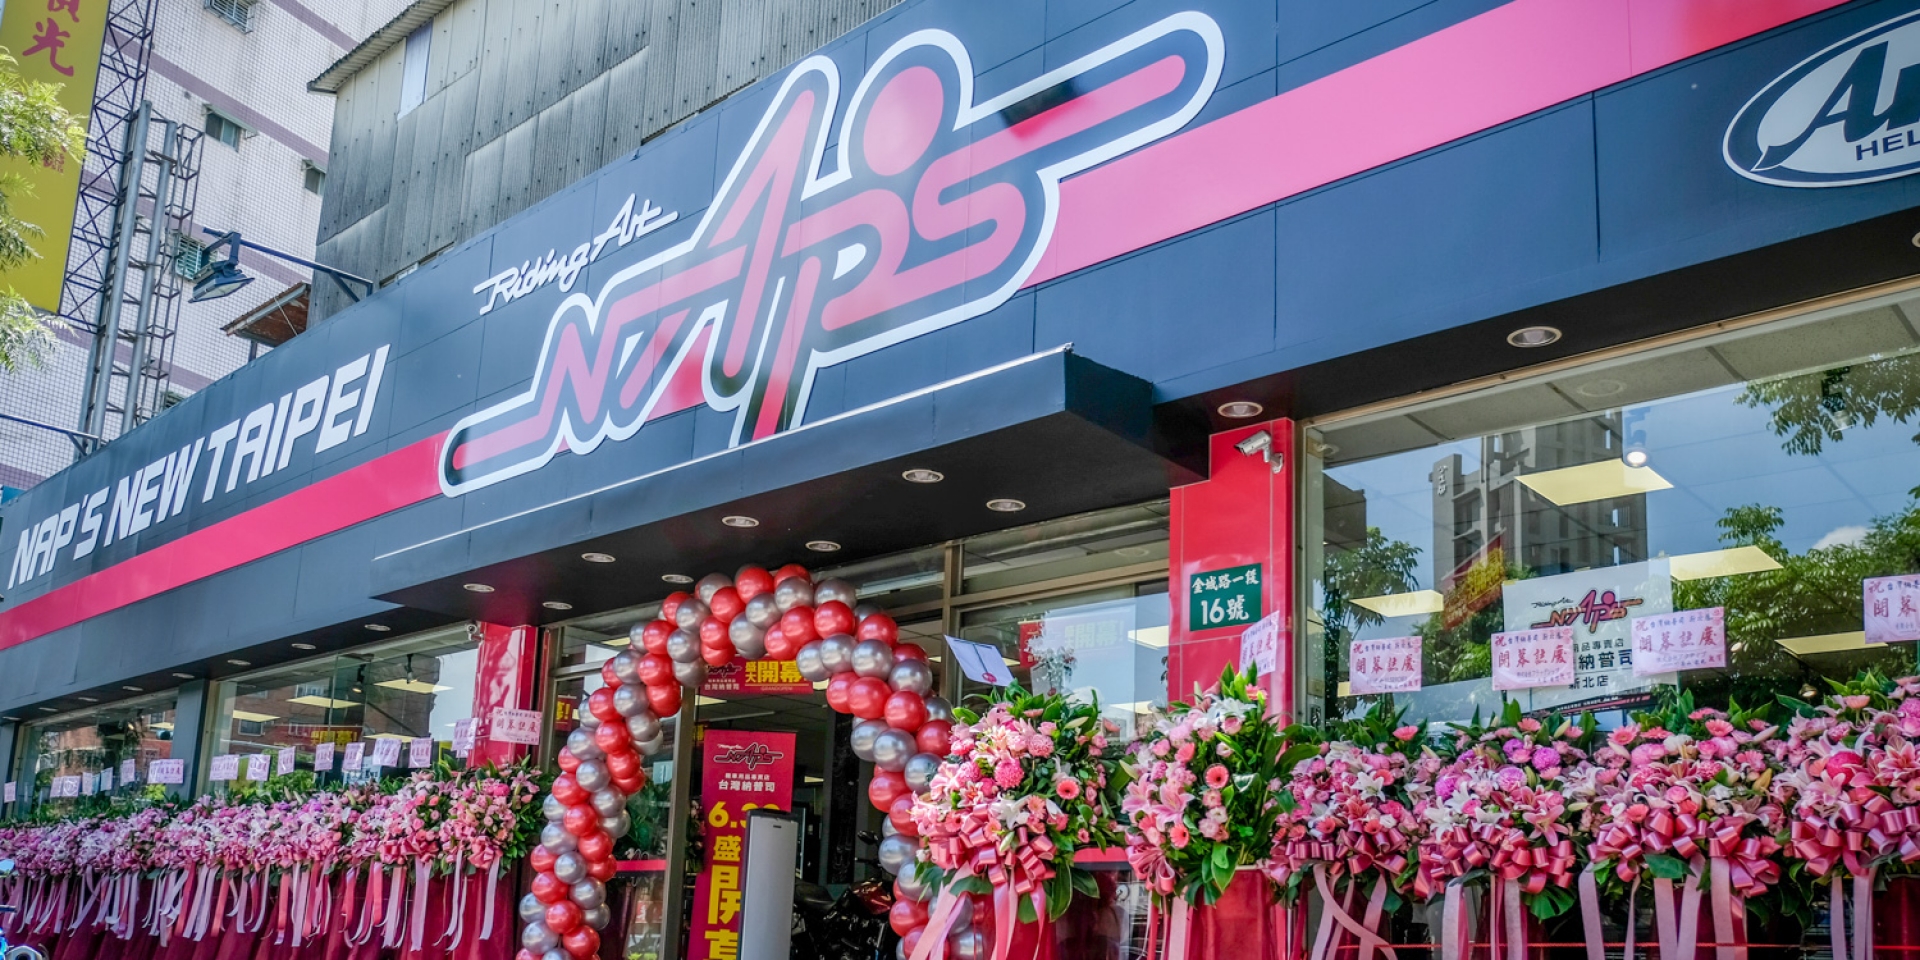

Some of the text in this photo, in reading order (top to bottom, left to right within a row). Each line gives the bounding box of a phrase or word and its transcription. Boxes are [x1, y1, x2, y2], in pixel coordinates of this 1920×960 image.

[23, 0, 80, 77] 光
[473, 193, 679, 316] Riding Art
[7, 343, 391, 591] NAP'S NEW TAIPEI
[1192, 568, 1260, 594] 金城路一段
[1201, 594, 1250, 625] 16號
